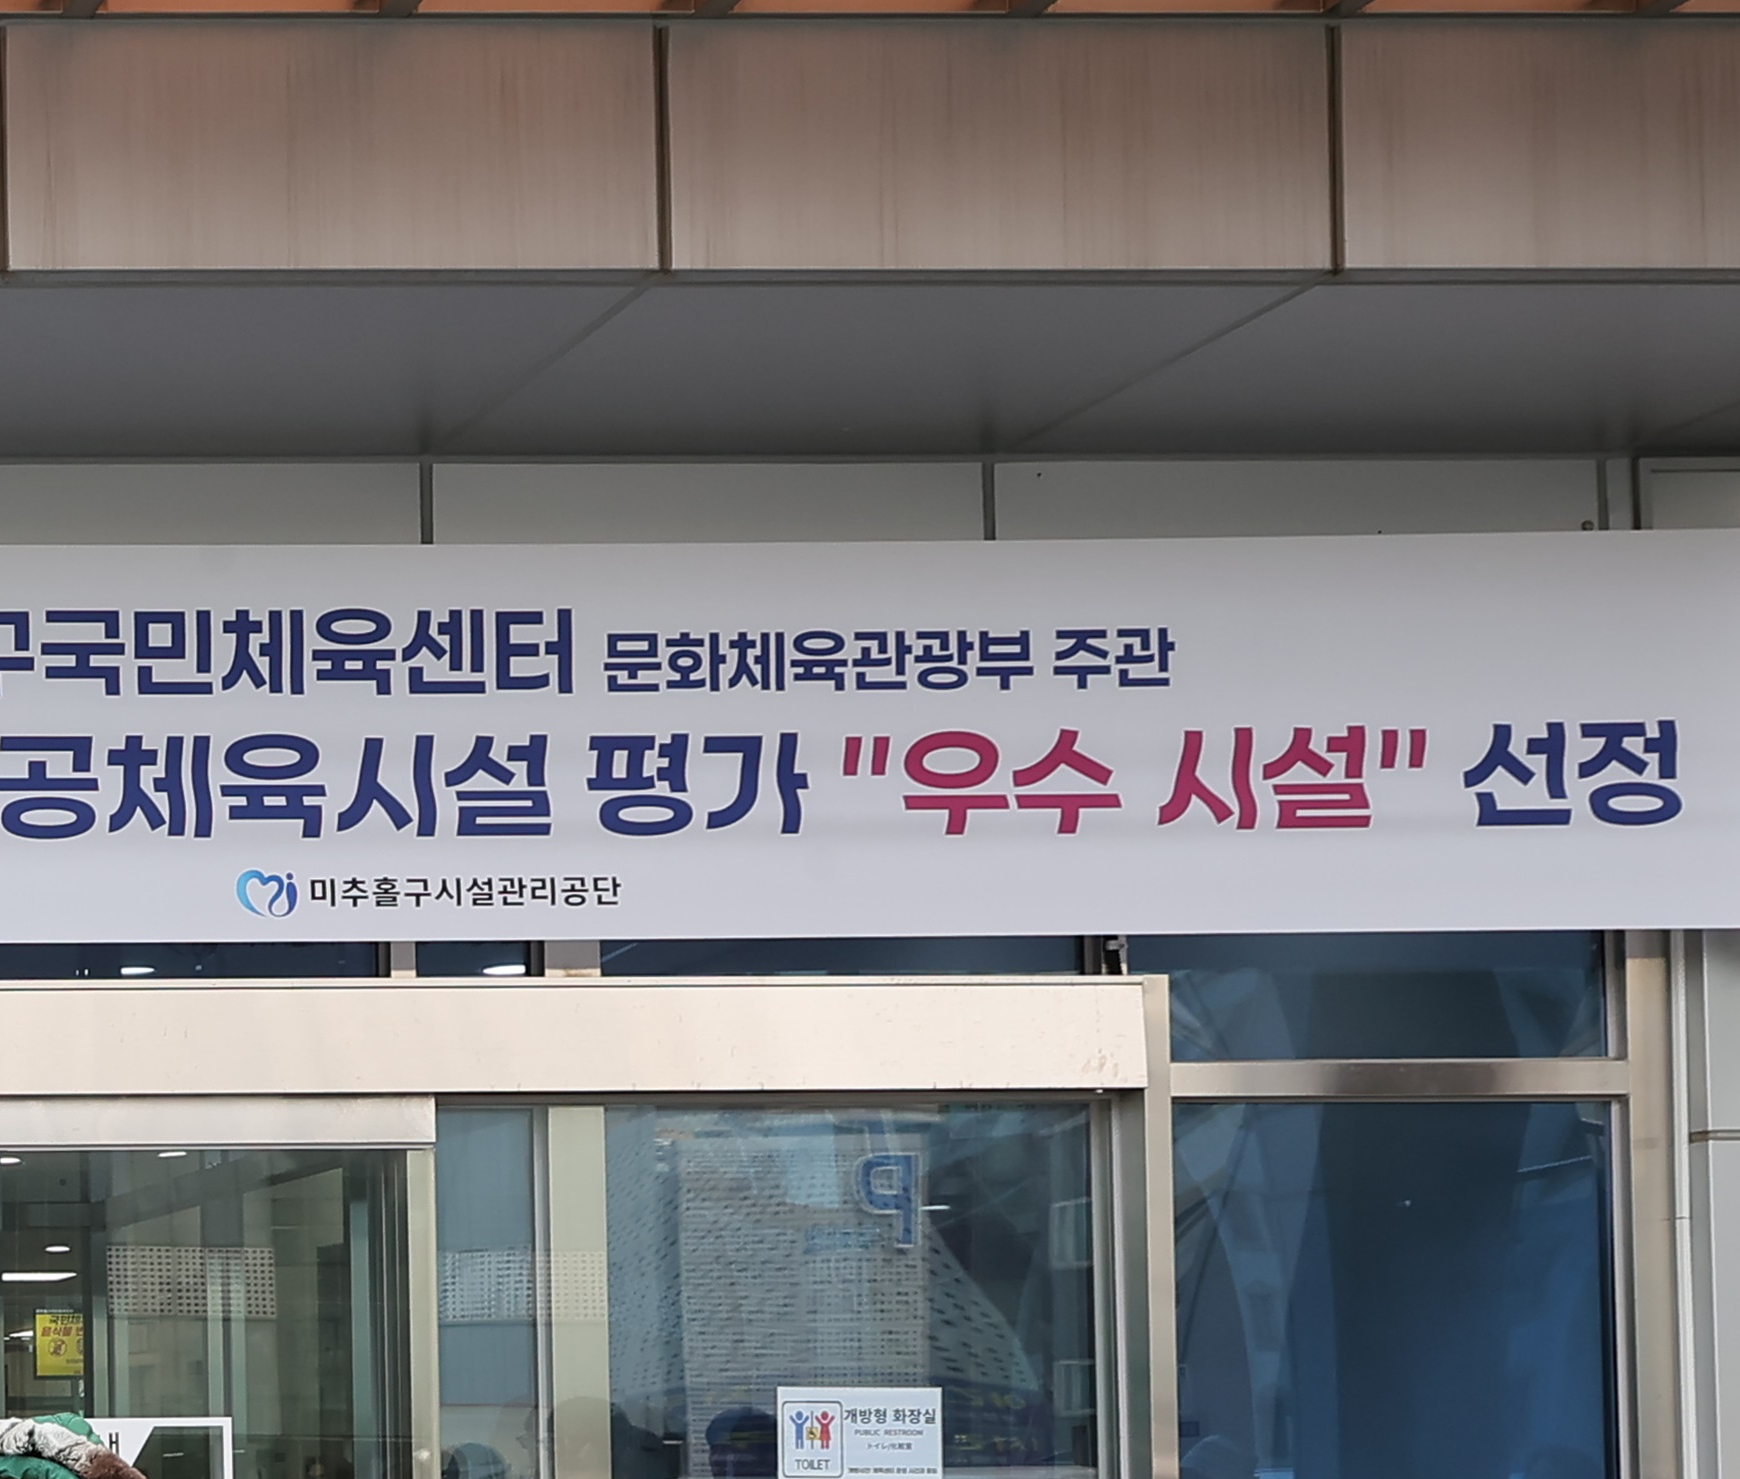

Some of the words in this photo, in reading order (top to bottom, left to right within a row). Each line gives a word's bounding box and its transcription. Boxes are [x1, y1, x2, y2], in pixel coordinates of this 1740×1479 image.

[603, 629, 1035, 693] 문화체육관광부
[1052, 627, 1176, 690] 주관
[585, 732, 810, 837] 평가
[841, 728, 1123, 836] "우수
[1156, 724, 1428, 831] 시설"
[1462, 718, 1683, 828] 선정
[309, 876, 622, 908] 미추홀구시설관리공단
[843, 1408, 887, 1424] 개방형
[892, 1408, 936, 1425] 화장실
[854, 1429, 881, 1437] PUBLIC
[883, 1429, 924, 1437] RESTROOM
[794, 1459, 830, 1470] TOILET
